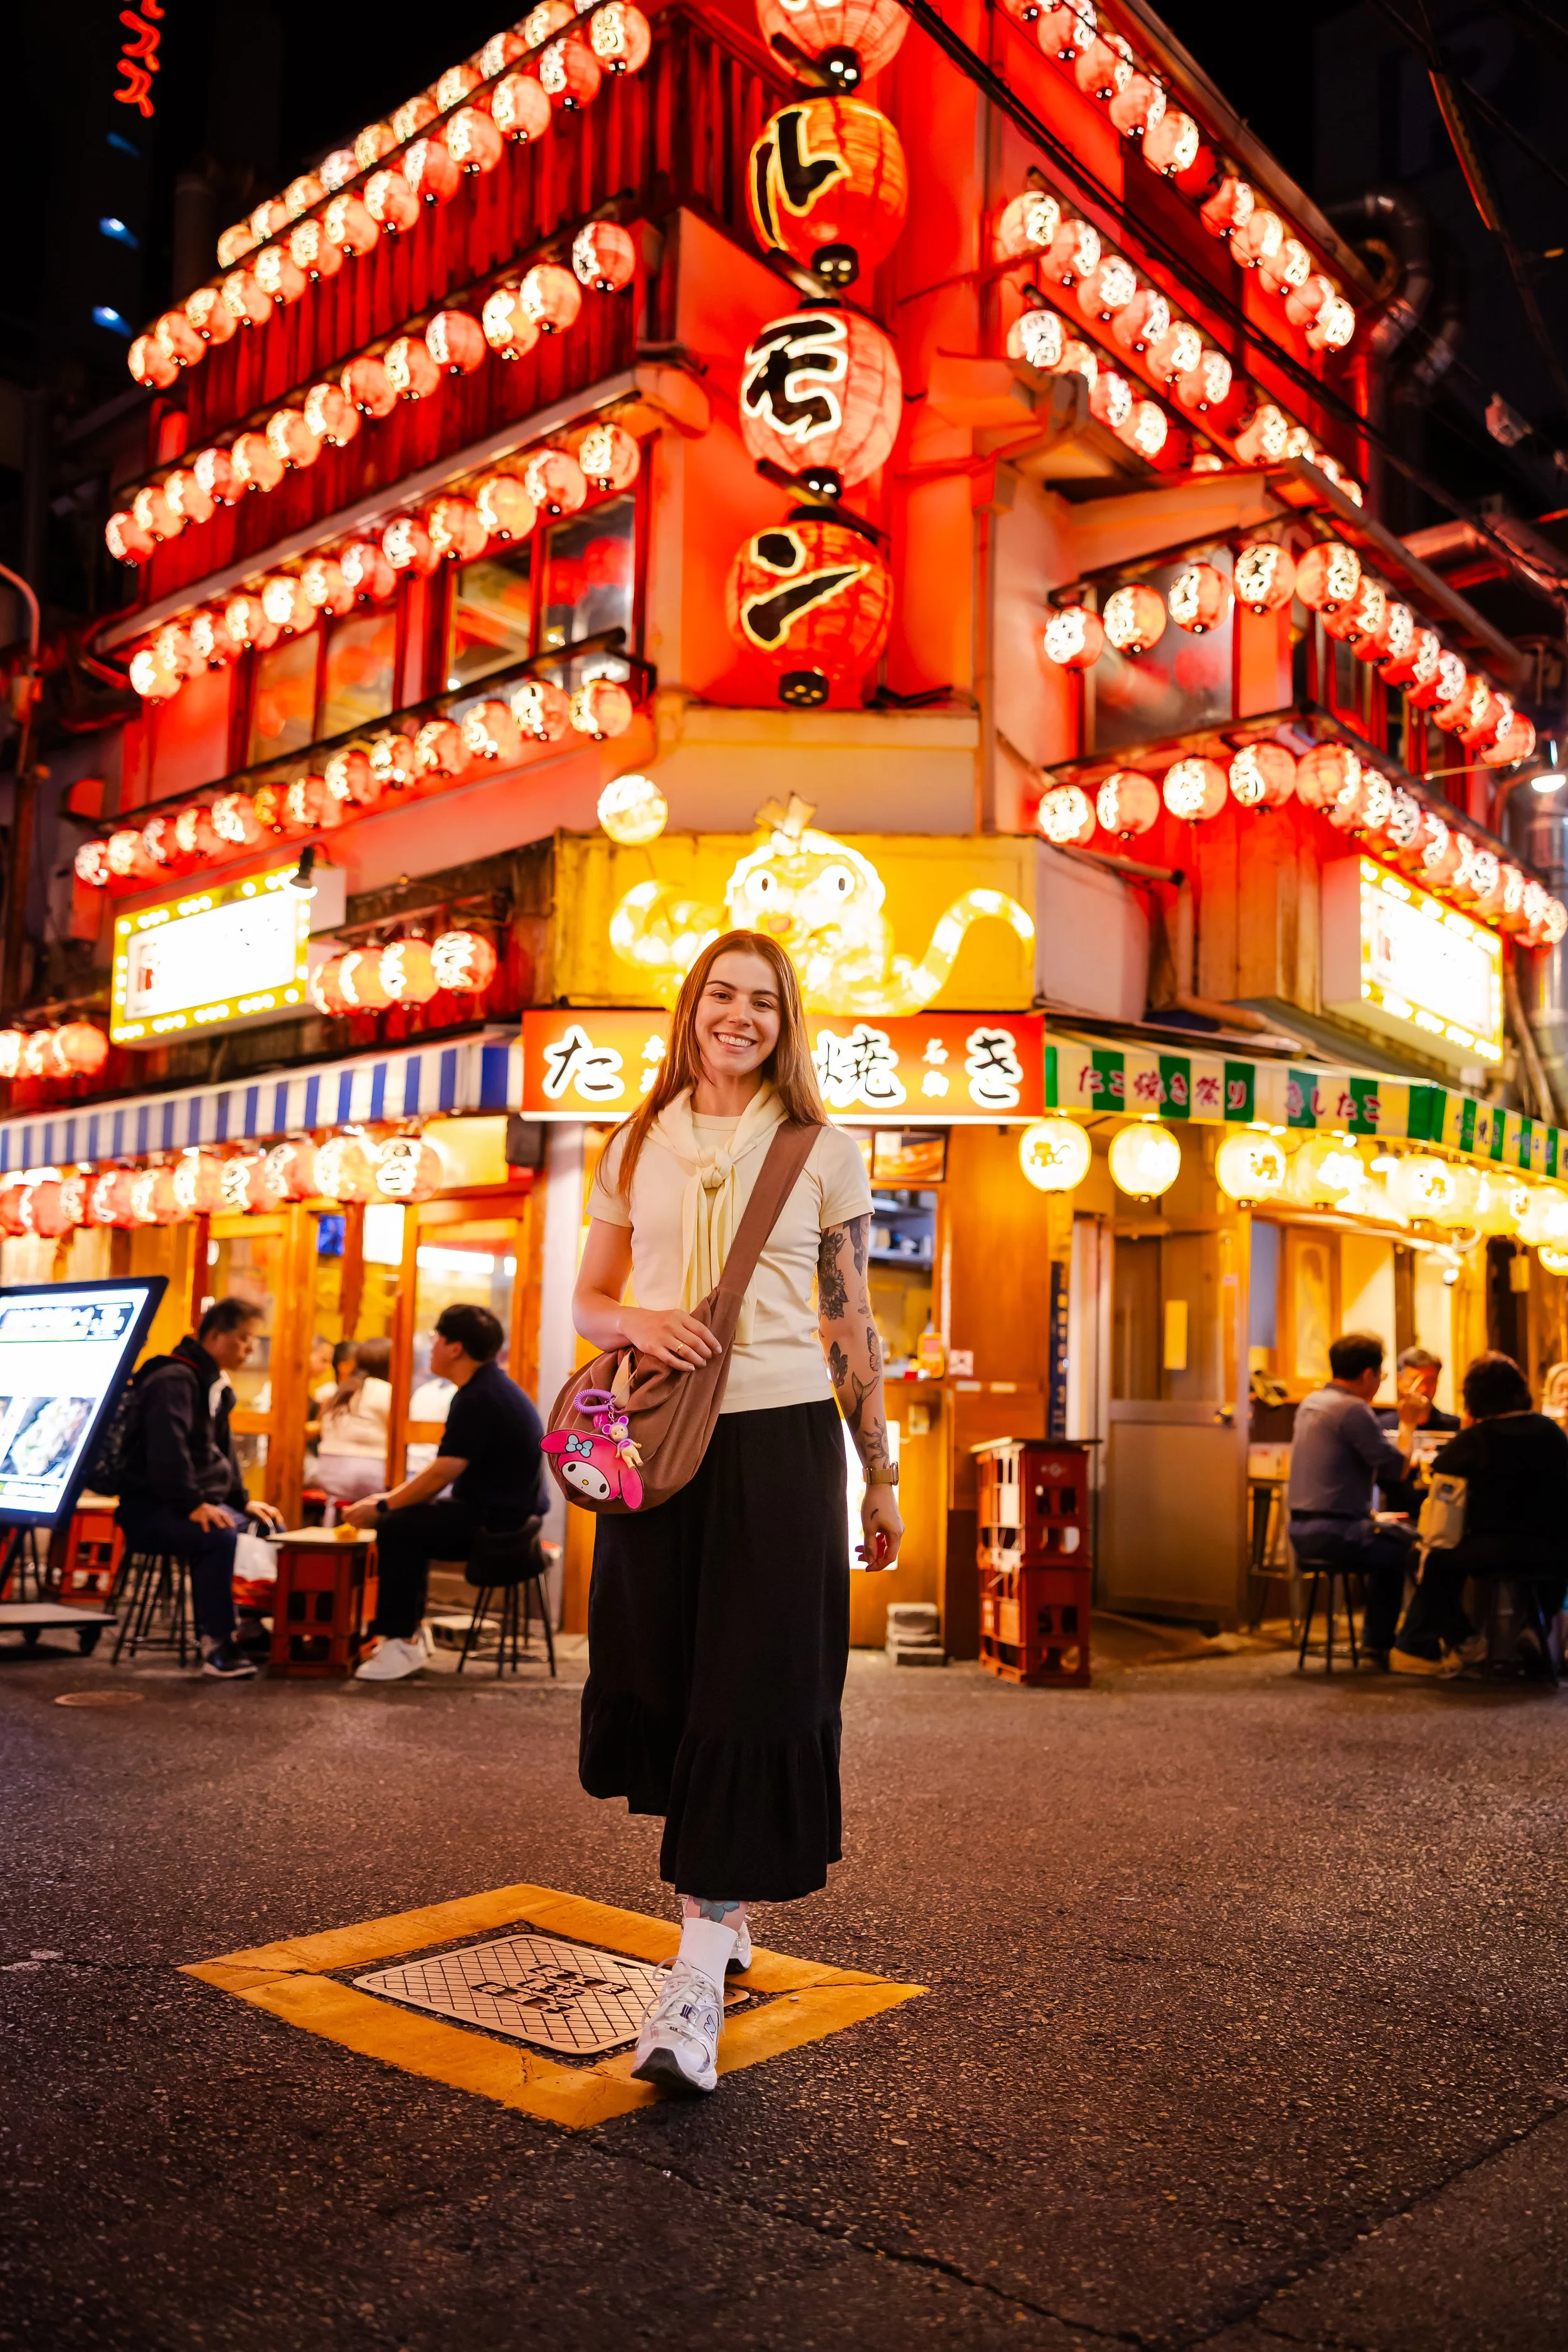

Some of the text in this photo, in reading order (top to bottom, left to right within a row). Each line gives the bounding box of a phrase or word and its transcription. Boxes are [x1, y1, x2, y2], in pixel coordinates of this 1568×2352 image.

[522, 1979, 580, 1998] 水道
[534, 1966, 625, 1994] 消火栓
[478, 1983, 563, 2012] 大阪市
